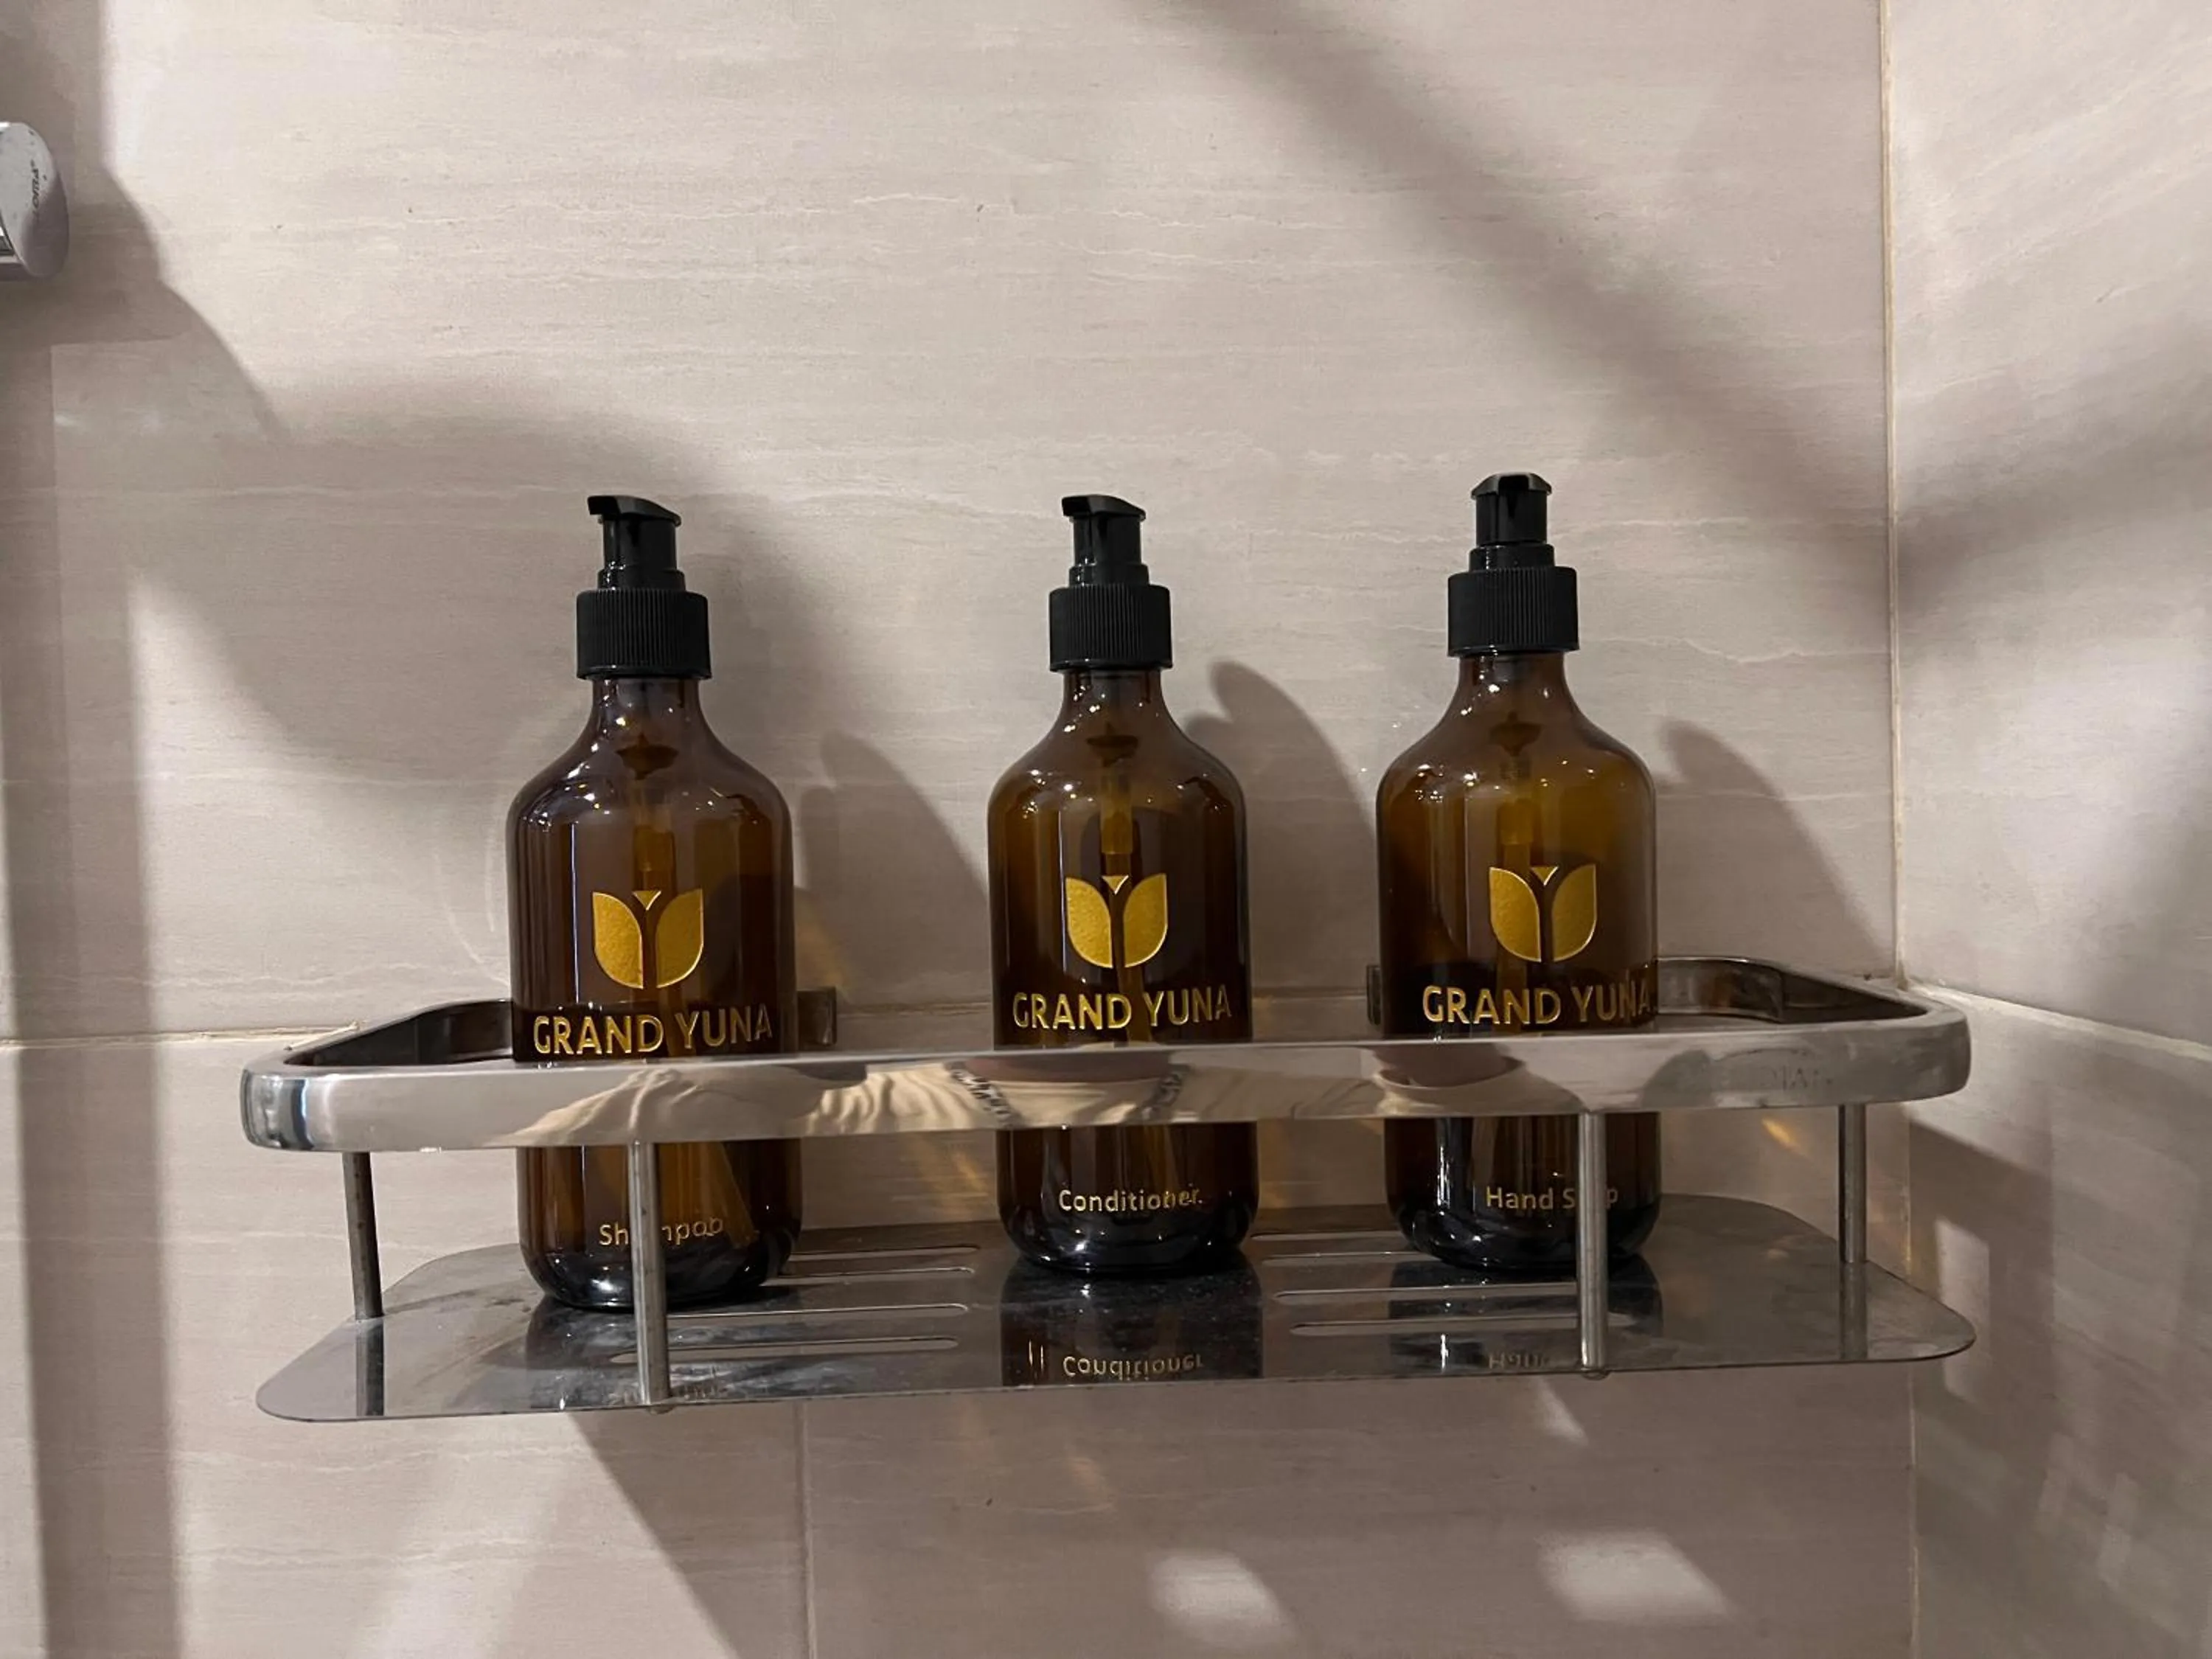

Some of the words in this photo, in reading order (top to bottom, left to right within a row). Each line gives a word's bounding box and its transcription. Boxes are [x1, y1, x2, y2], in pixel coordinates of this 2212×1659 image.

[1012, 992, 1133, 1030] GRAND
[1143, 984, 1232, 1027] YUNA
[1422, 985, 1562, 1025] GRAND
[1571, 979, 1650, 1023] YUNA
[533, 1015, 664, 1055] GRAND
[674, 1002, 773, 1049] YUNA
[1486, 1185, 1554, 1210] Hand
[1562, 1186, 1619, 1210] Sp
[599, 1217, 724, 1245] Shpoo
